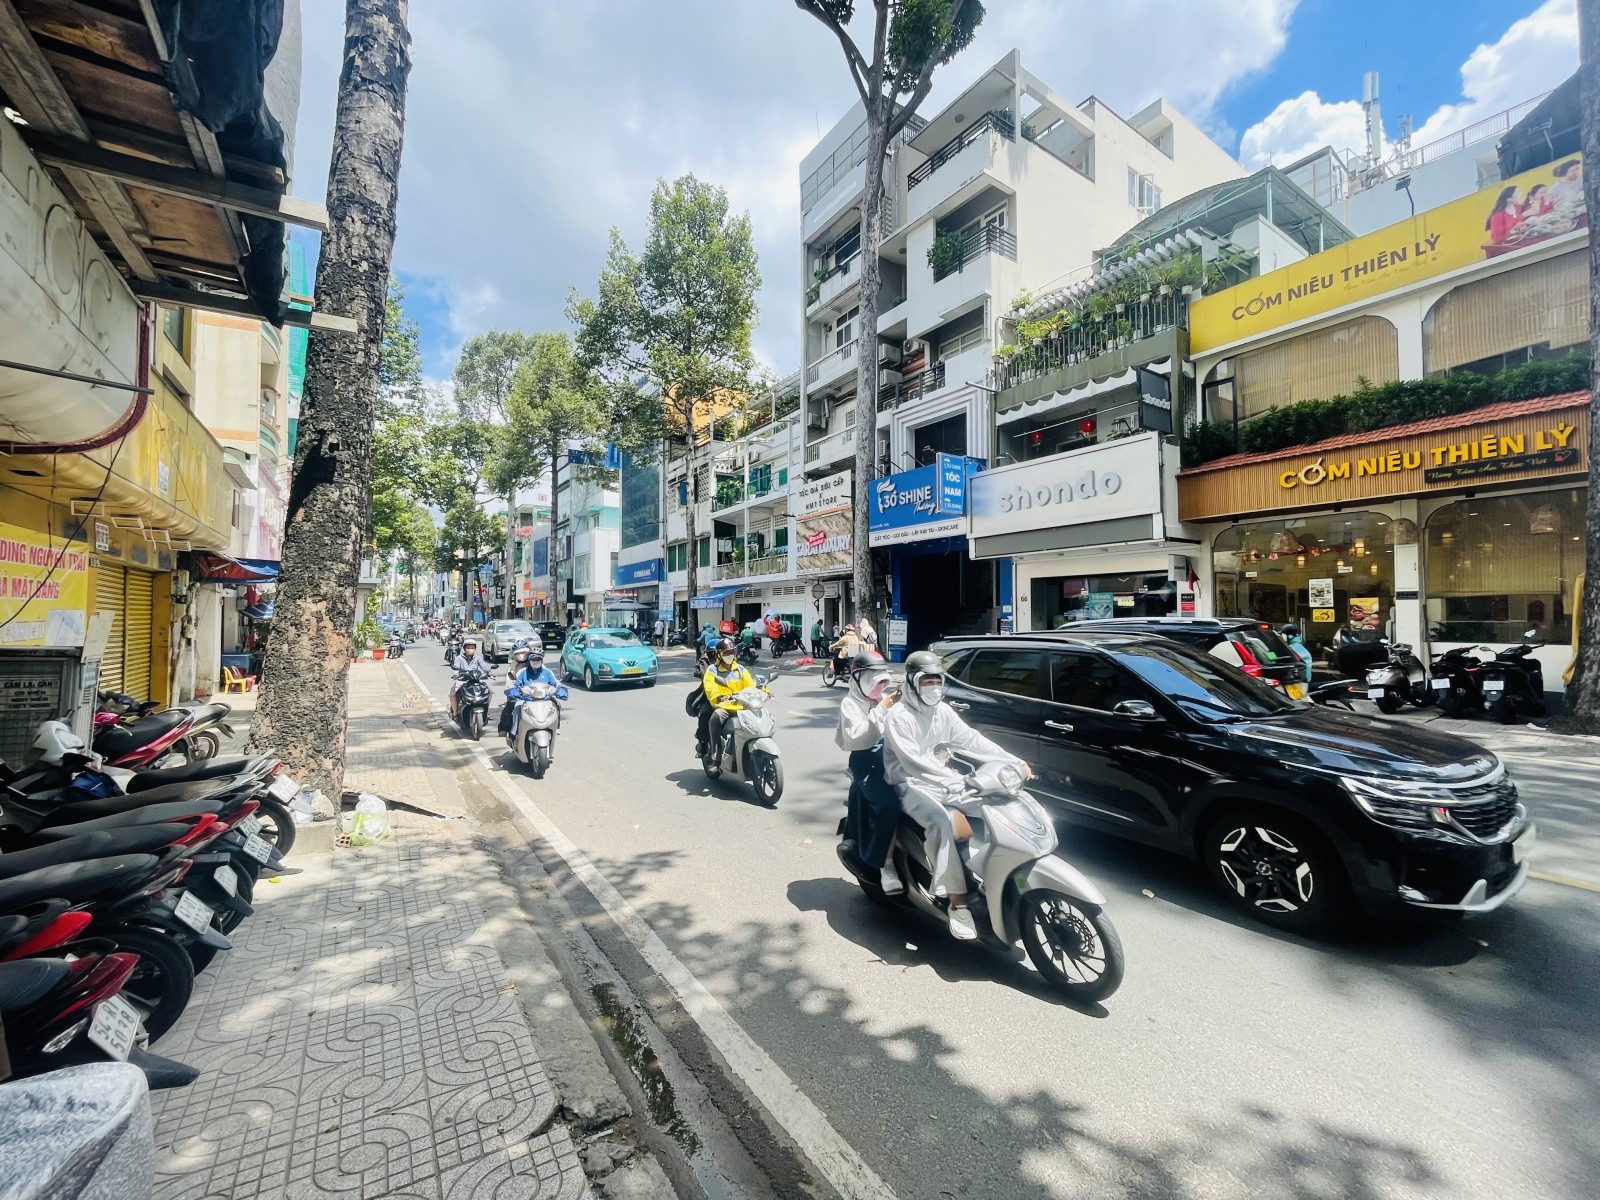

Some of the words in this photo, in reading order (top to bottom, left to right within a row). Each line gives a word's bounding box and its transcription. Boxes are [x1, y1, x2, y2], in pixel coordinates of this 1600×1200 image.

[945, 471, 960, 483] TÓC
[899, 485, 932, 505] SHINE
[945, 487, 961, 497] NAM
[998, 470, 1122, 513] shondo
[819, 496, 837, 507] STORE
[938, 524, 959, 532] SKINCARE
